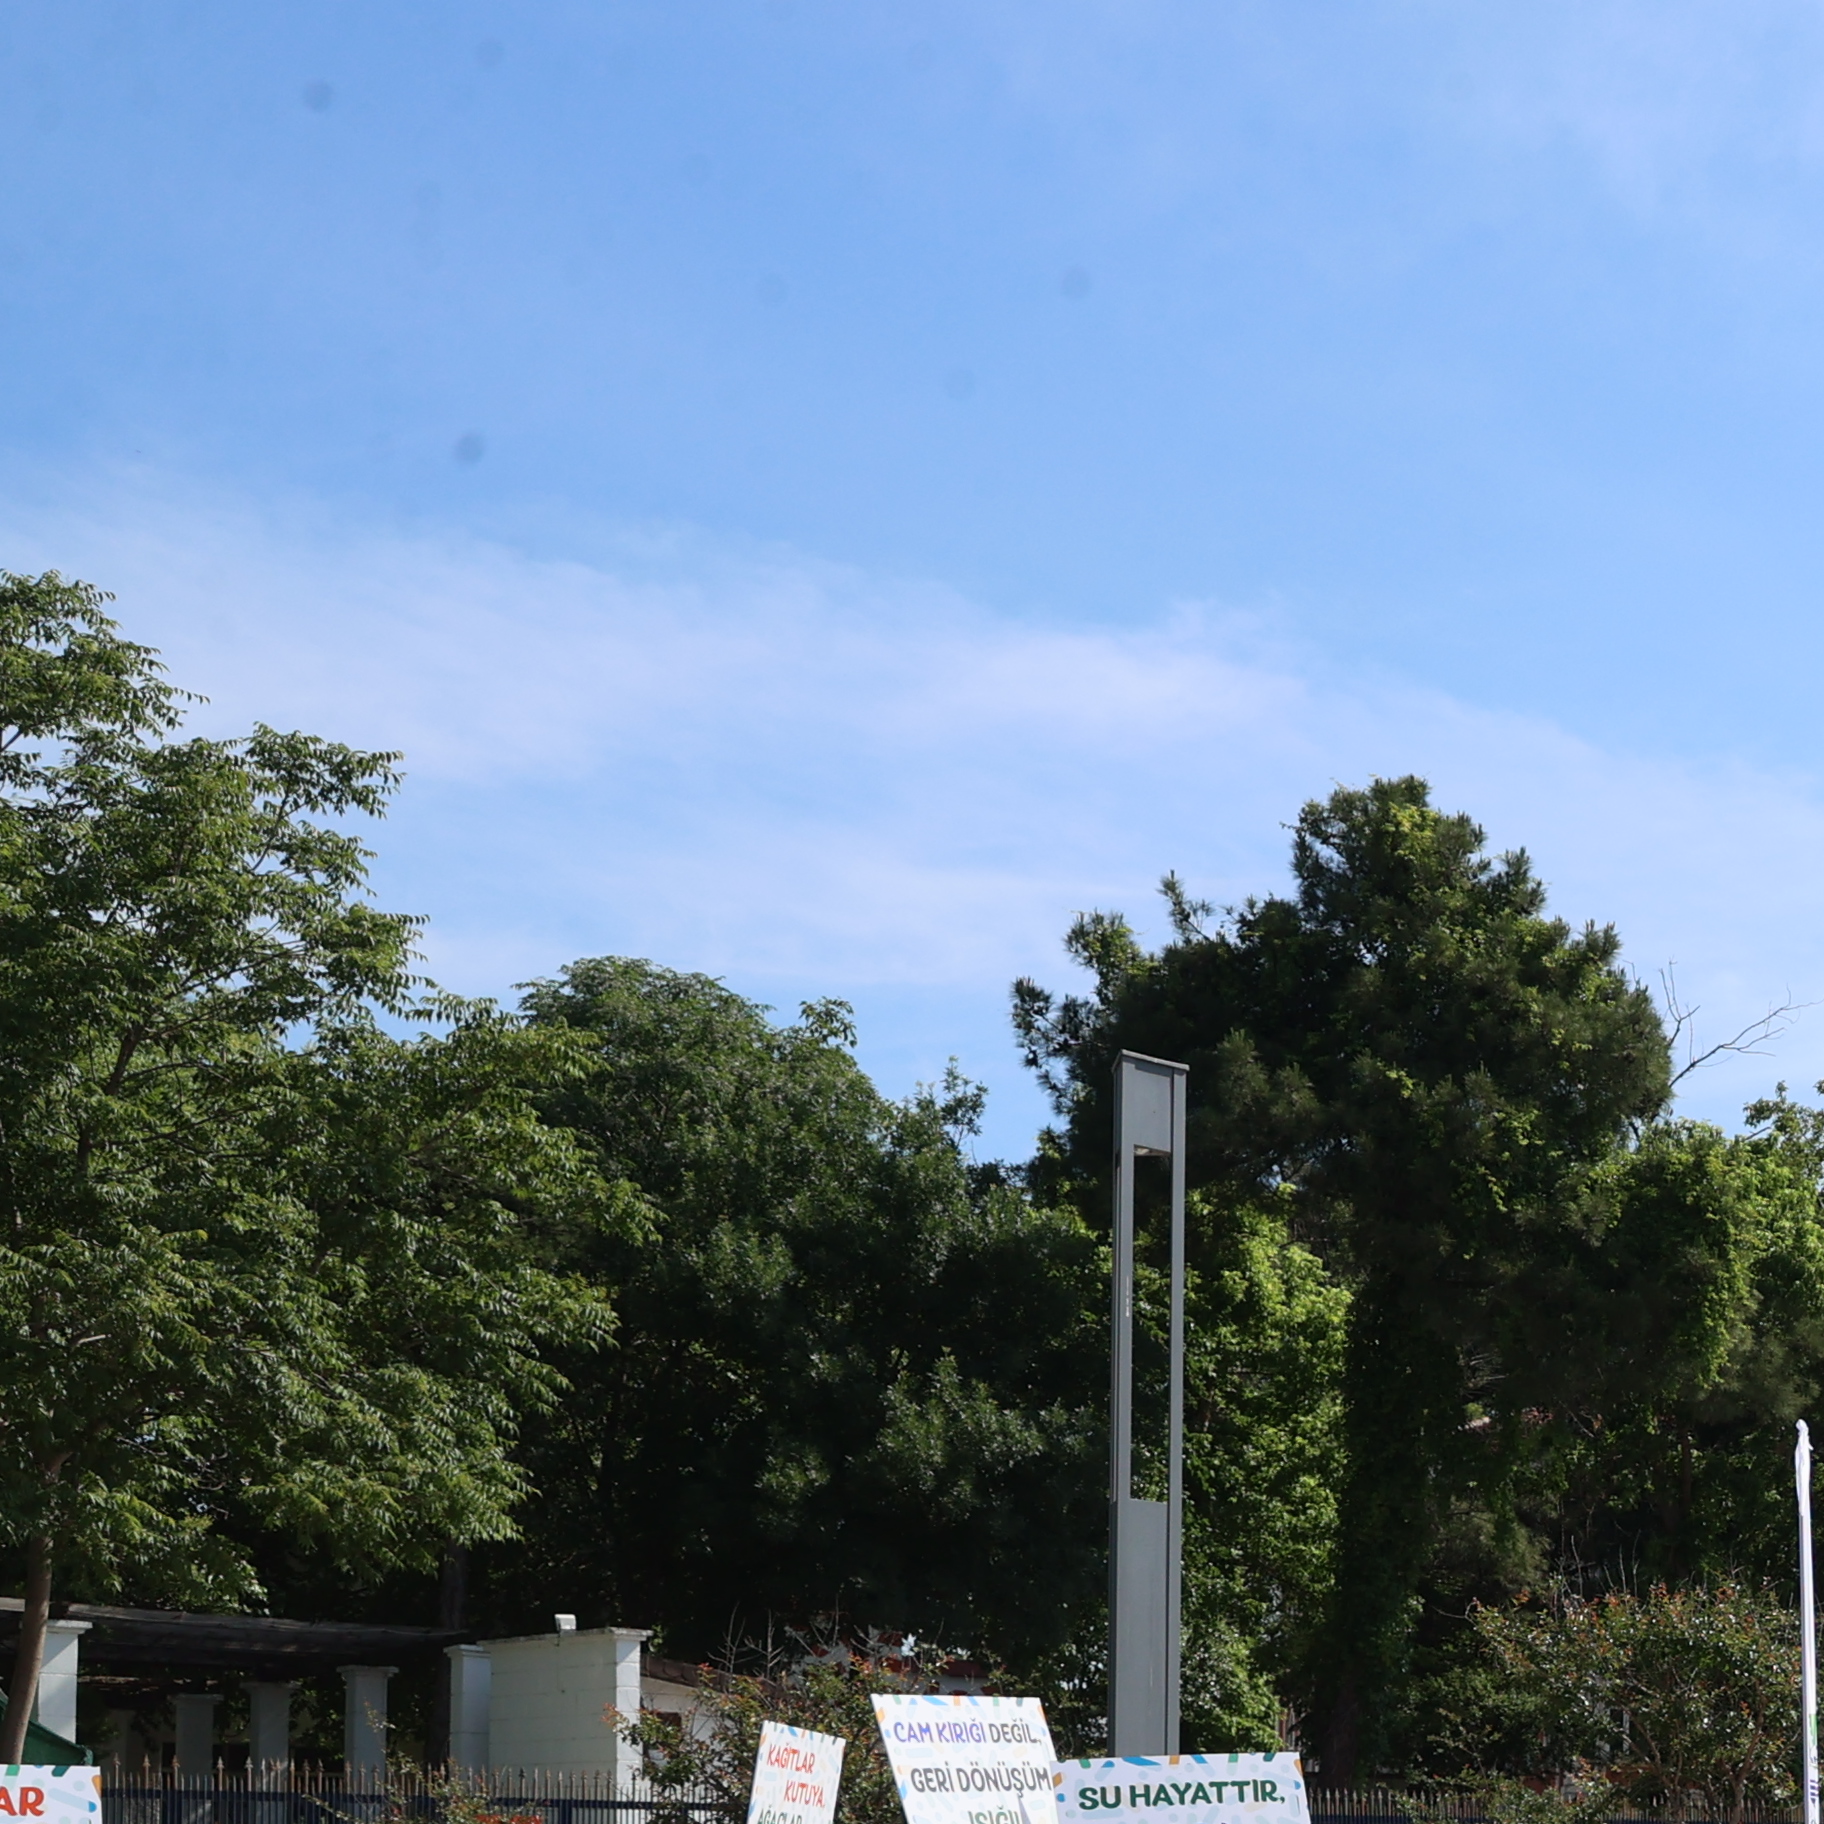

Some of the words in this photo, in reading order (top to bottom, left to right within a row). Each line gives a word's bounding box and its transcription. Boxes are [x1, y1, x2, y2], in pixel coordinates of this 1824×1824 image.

[894, 1720, 931, 1743] CAM
[938, 1717, 987, 1743] KIRIĞI
[911, 1762, 954, 1793] GERİ
[959, 1761, 1051, 1798] DÖNÜŞÜM
[1078, 1785, 1121, 1811] SU
[1129, 1779, 1285, 1808] HAYATTIR,
